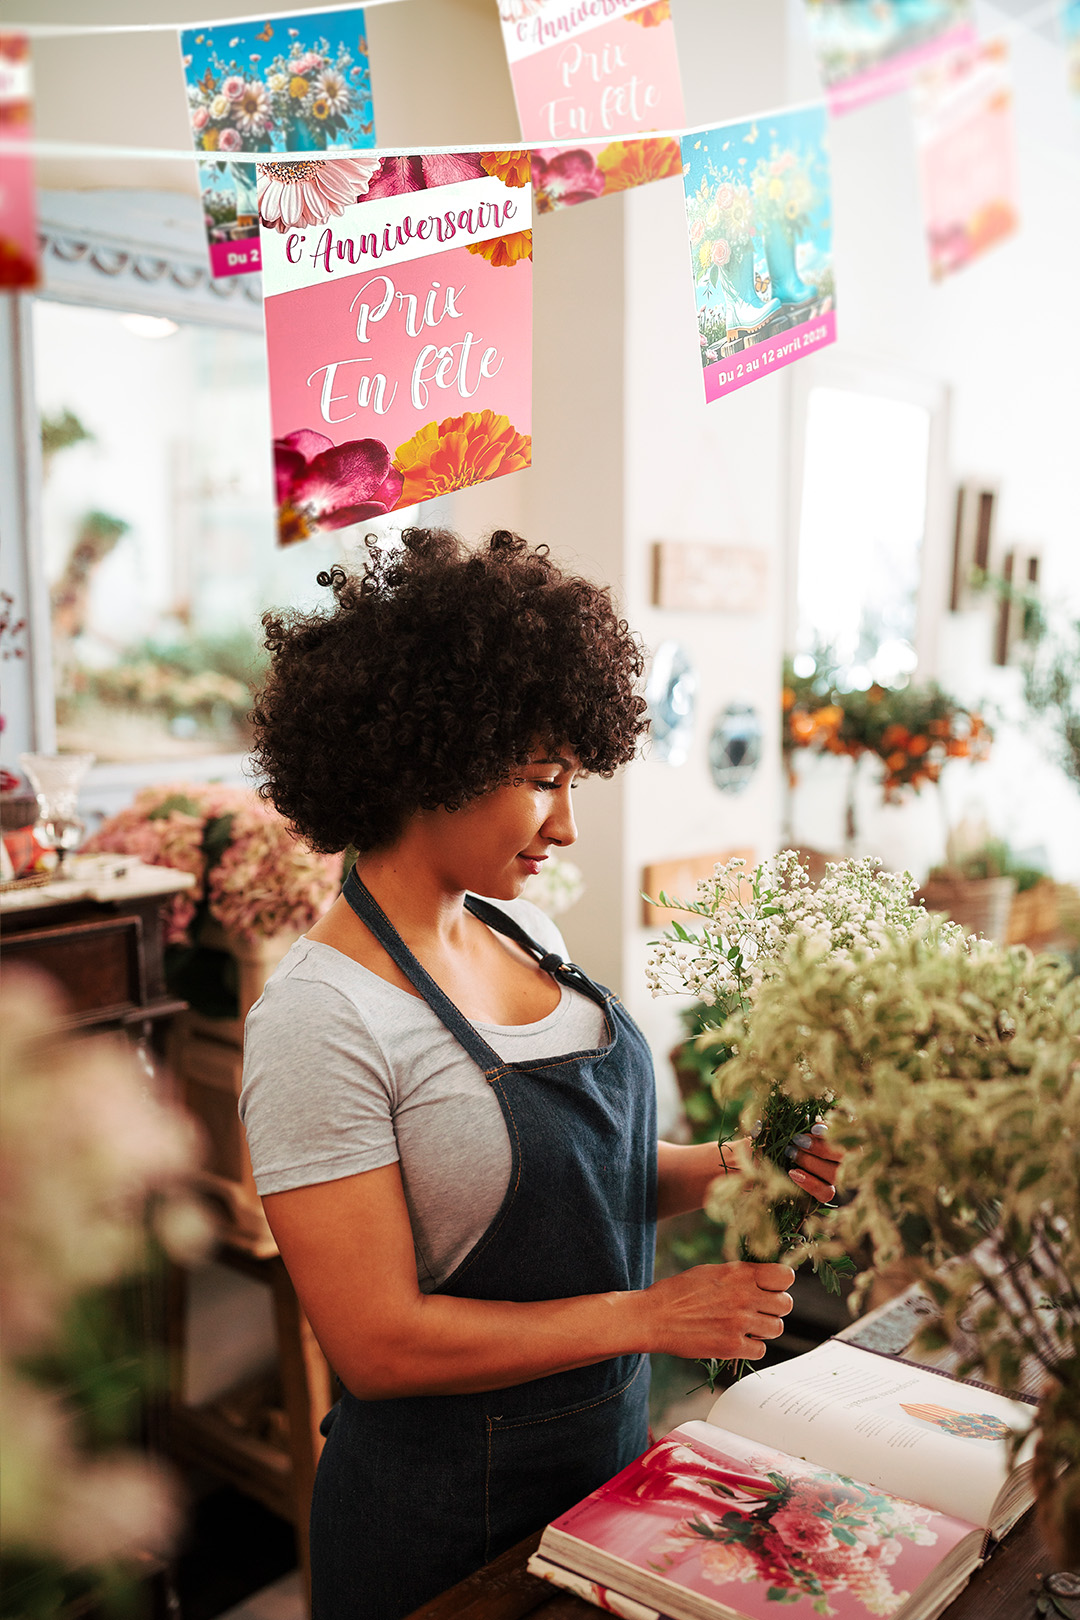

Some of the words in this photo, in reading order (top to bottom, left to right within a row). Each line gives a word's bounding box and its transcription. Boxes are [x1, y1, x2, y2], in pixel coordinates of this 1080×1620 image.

[557, 42, 628, 88] Prix
[539, 96, 592, 139] En
[601, 75, 662, 130] fête
[227, 252, 247, 266] Du
[250, 249, 259, 262] 2
[350, 275, 466, 343] Prix
[307, 358, 398, 424] En
[411, 332, 504, 410] fête
[718, 370, 734, 386] Du
[736, 364, 744, 378] 2
[746, 358, 759, 373] au
[761, 350, 775, 366] 12
[776, 337, 801, 358] avril
